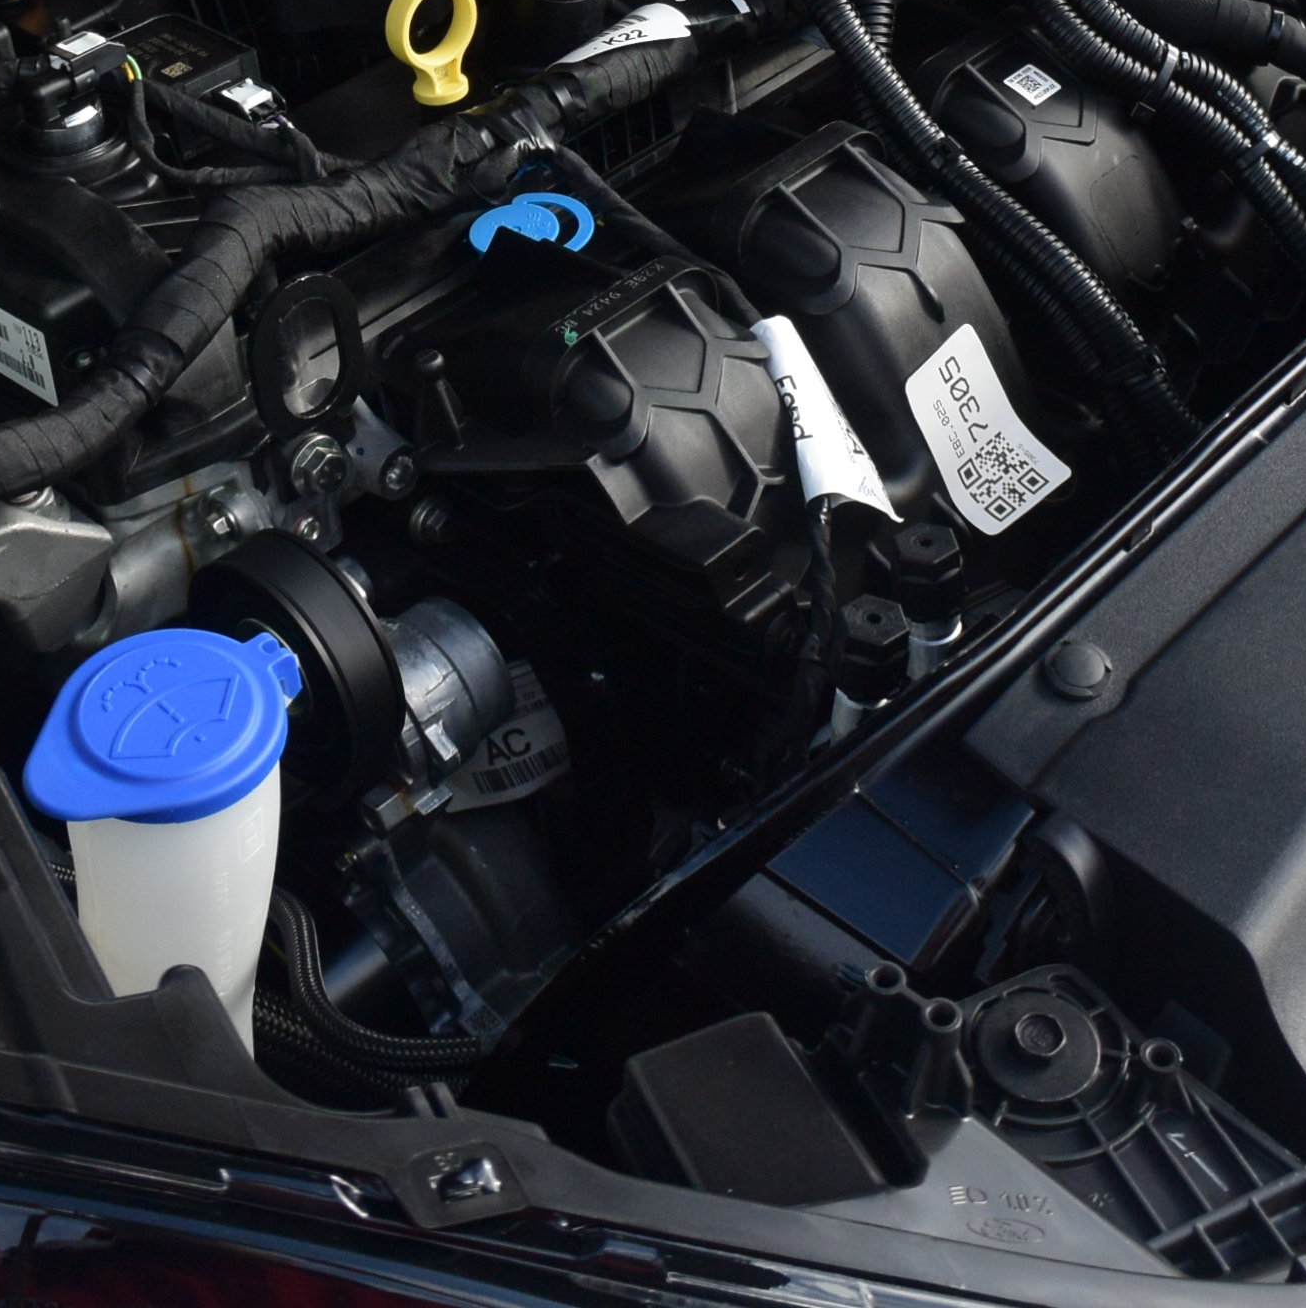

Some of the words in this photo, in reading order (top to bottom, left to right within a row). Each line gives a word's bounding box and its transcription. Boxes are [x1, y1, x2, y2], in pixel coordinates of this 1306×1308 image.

[602, 29, 649, 47] K22
[774, 375, 813, 443] Ford
[939, 356, 989, 444] 7305
[484, 728, 531, 768] AC
